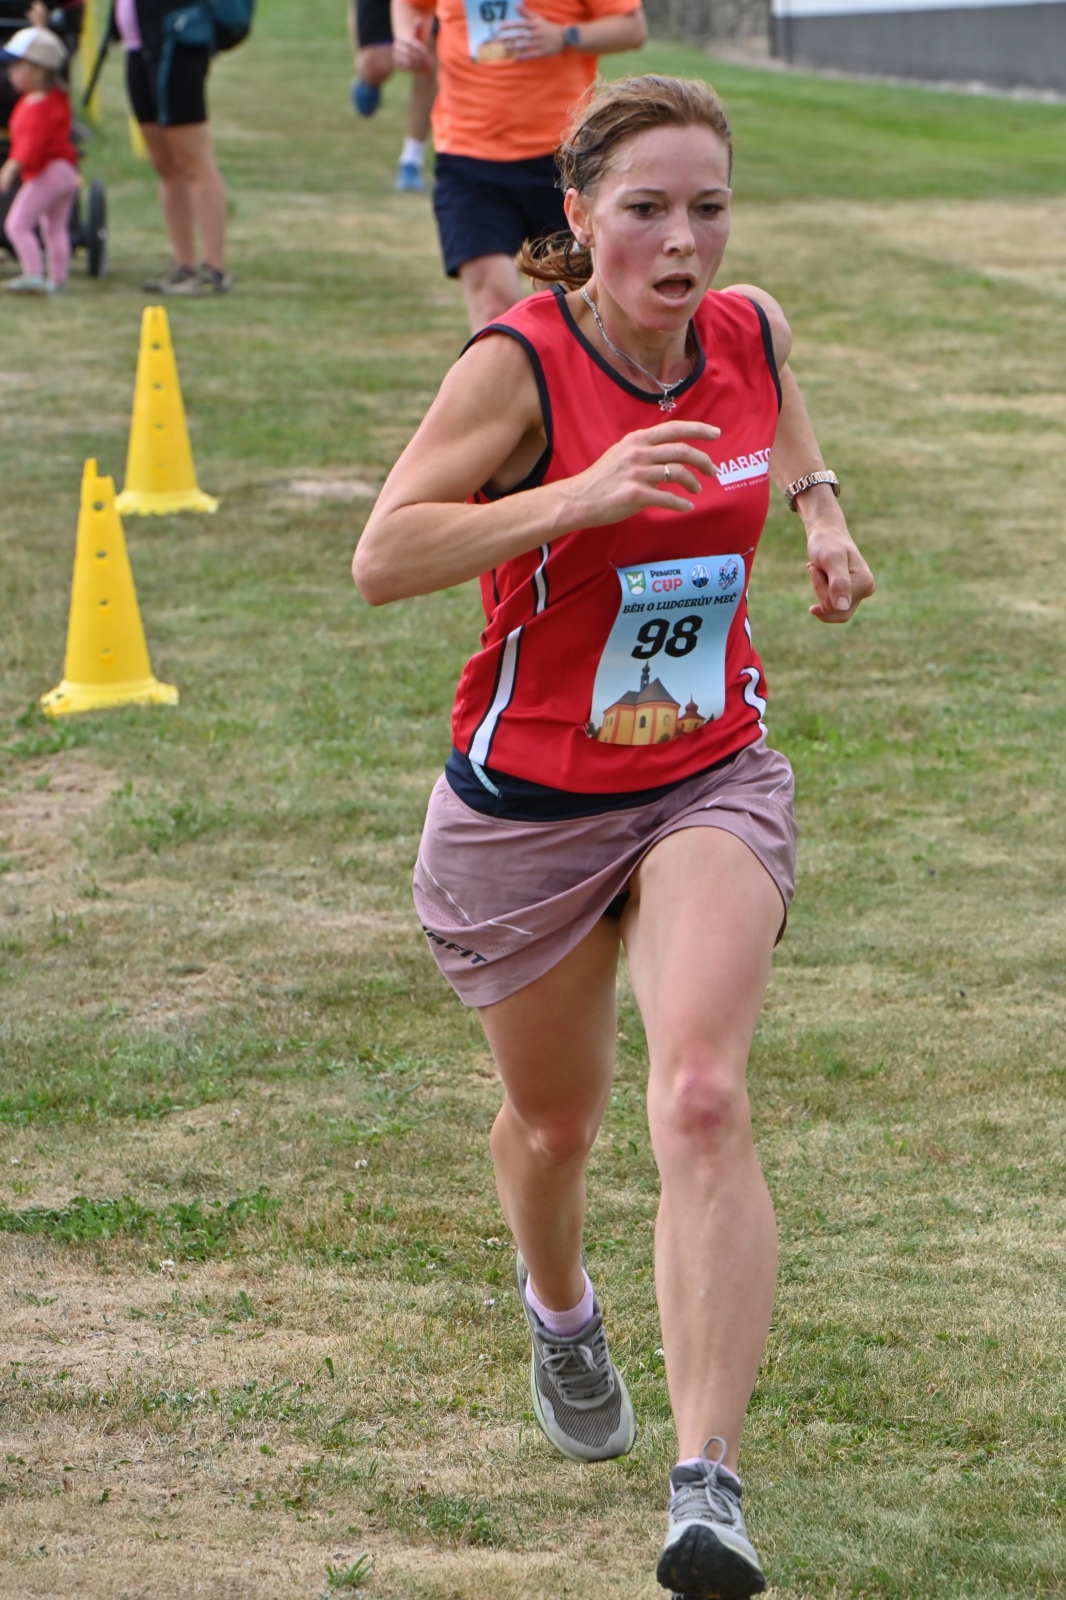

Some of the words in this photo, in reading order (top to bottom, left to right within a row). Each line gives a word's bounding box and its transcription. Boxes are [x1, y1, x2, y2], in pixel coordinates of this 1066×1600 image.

[479, 0, 508, 23] 67
[652, 578, 683, 593] CUP
[622, 602, 645, 614] BĚH
[646, 602, 655, 611] O
[656, 595, 713, 610] LUDGERŮV
[713, 593, 737, 605] MEČ
[630, 615, 703, 660] 98
